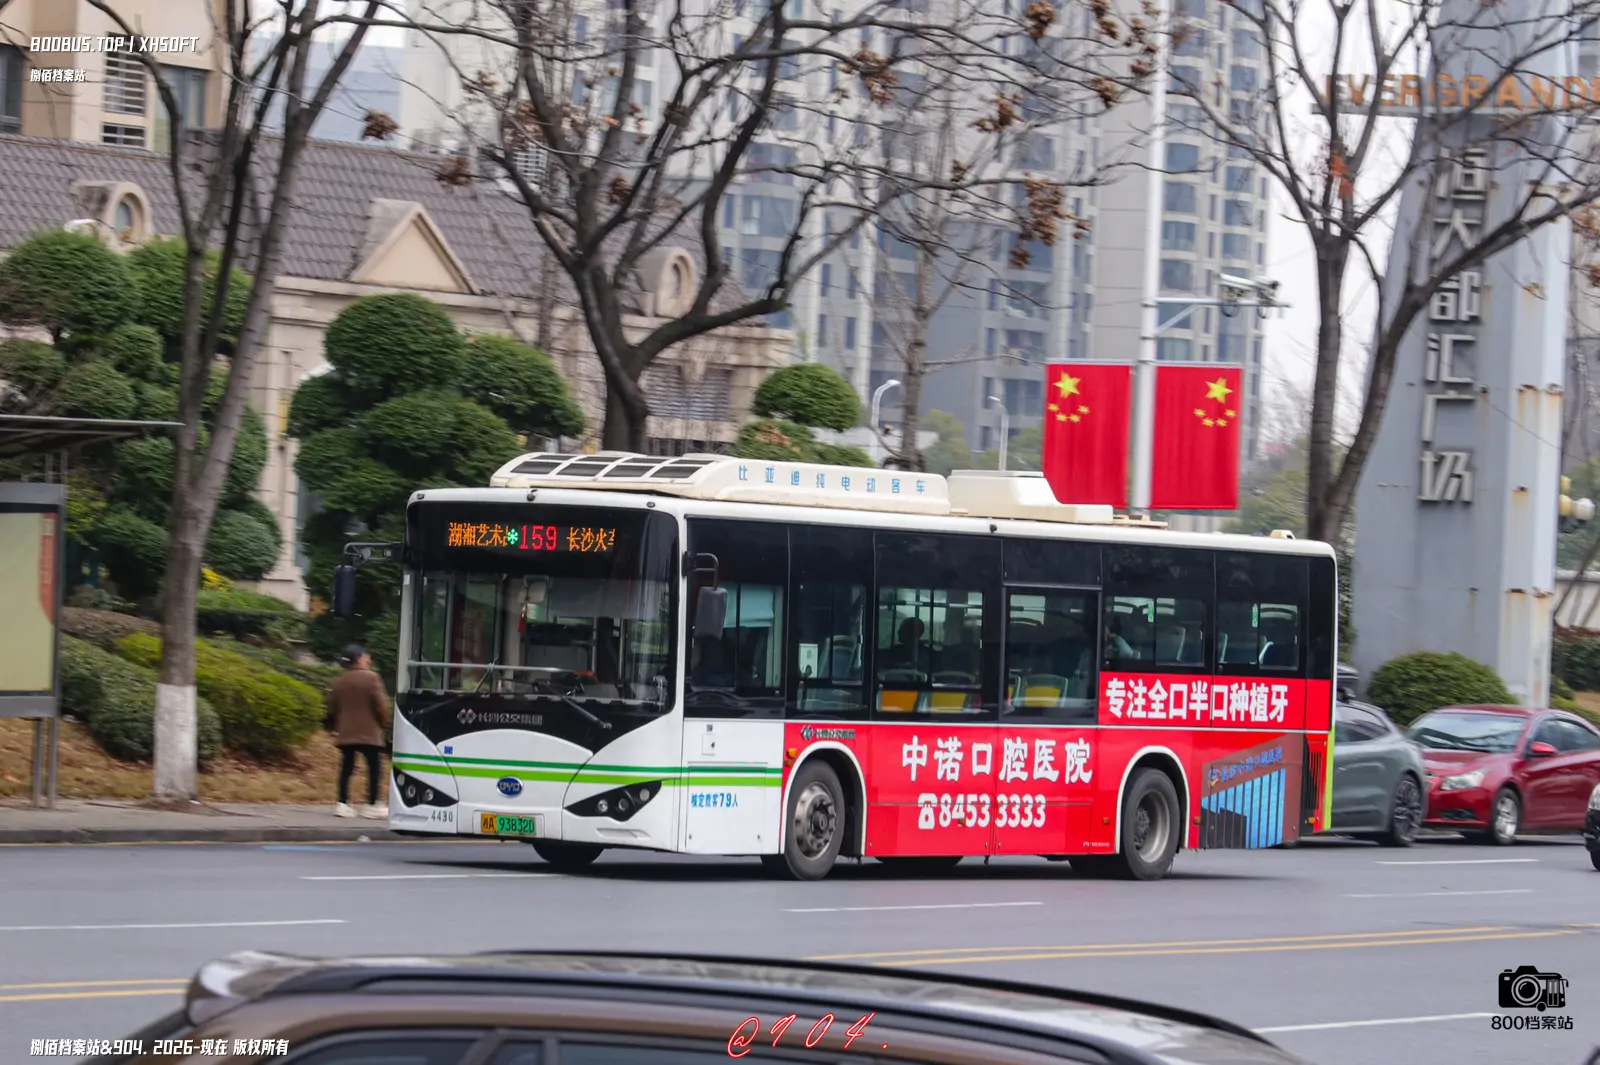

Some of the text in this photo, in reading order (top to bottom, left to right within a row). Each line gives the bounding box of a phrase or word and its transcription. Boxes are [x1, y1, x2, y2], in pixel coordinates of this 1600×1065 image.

[1418, 147, 1487, 504] 恒大都汇广场
[738, 465, 926, 494] 比亚迪纯电动客车
[519, 525, 558, 551] 159
[1106, 678, 1289, 723] 专注全口半口种植牙
[902, 735, 1093, 784] 中诺口腔医院
[430, 811, 453, 823] 4430
